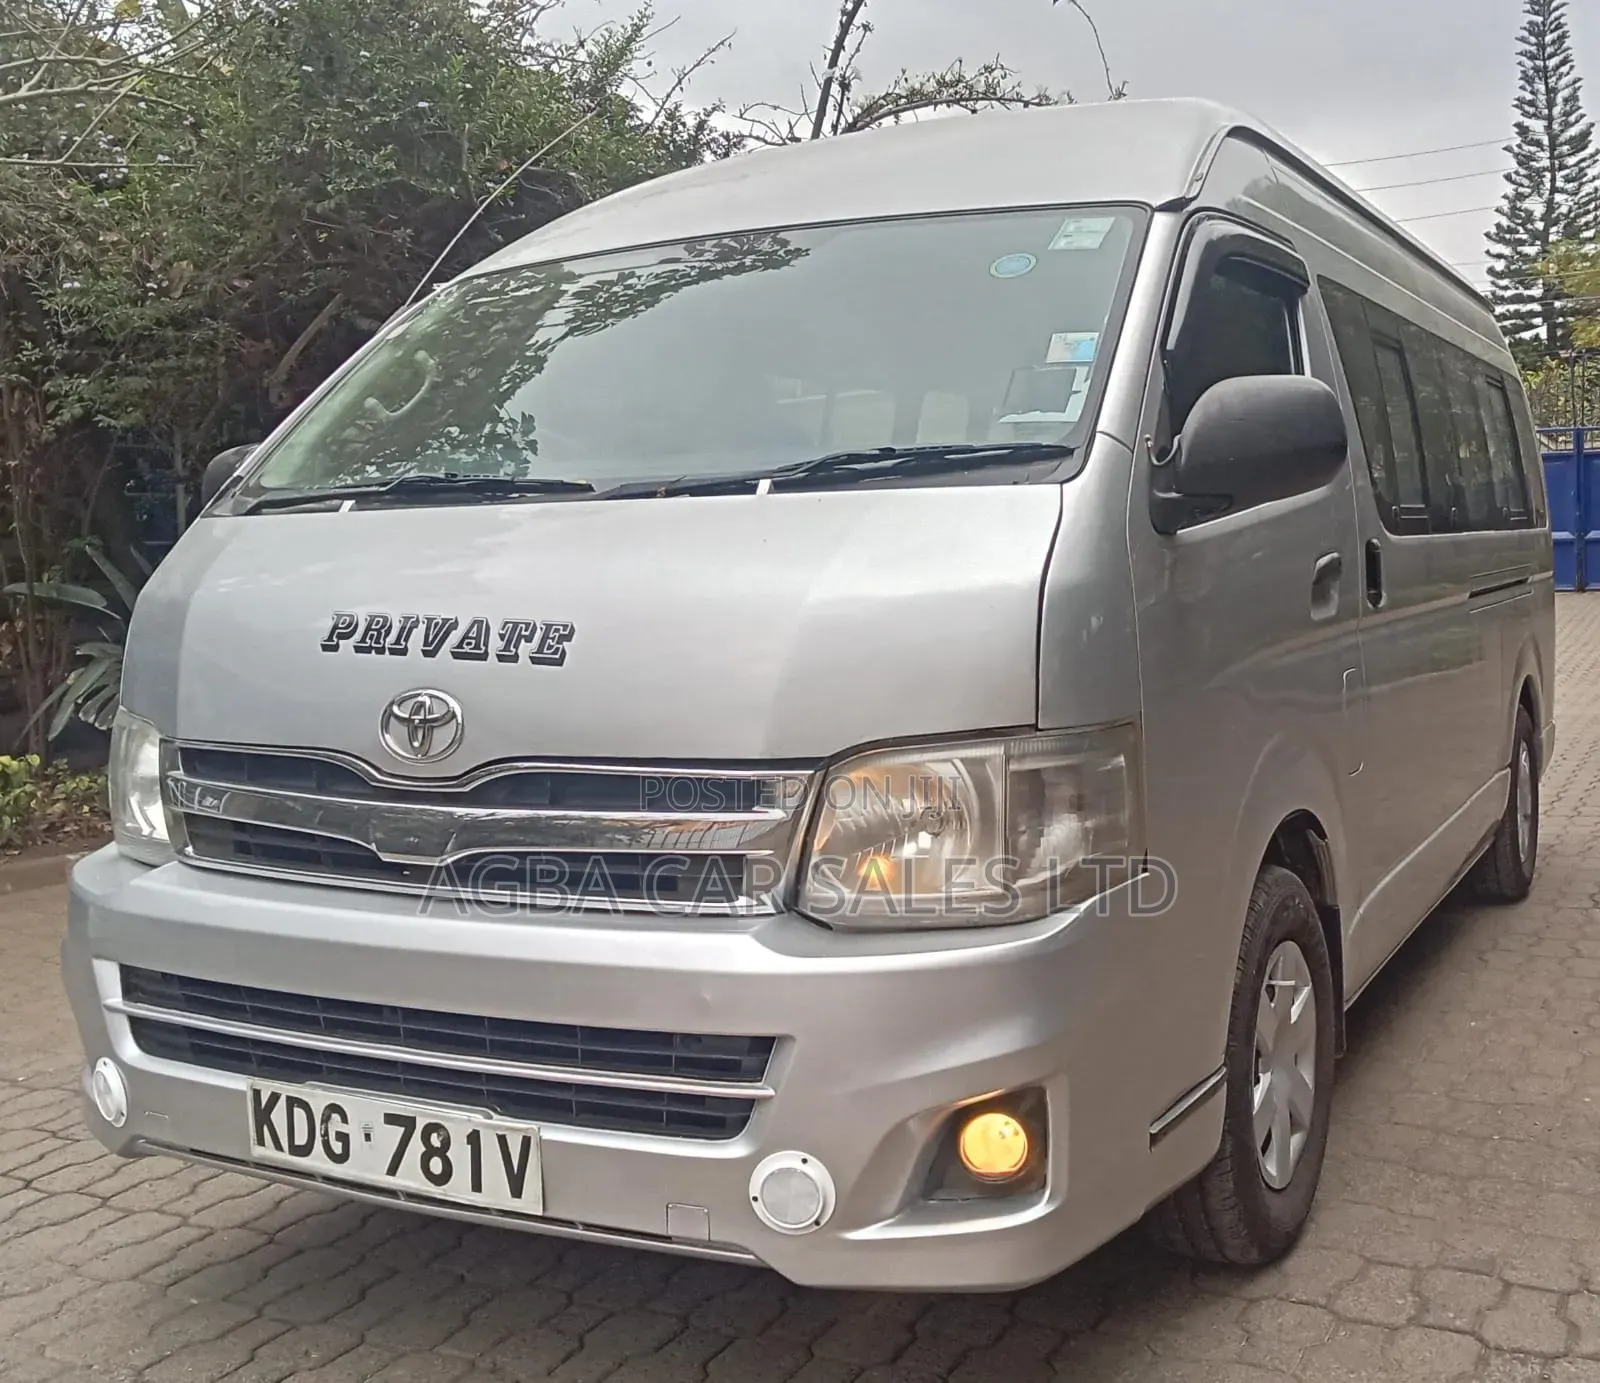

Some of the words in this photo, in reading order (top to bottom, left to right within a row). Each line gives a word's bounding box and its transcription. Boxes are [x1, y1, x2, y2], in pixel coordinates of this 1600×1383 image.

[320, 611, 576, 667] PRIVATE
[252, 1088, 351, 1164] KDG
[383, 1112, 532, 1200] 781V
